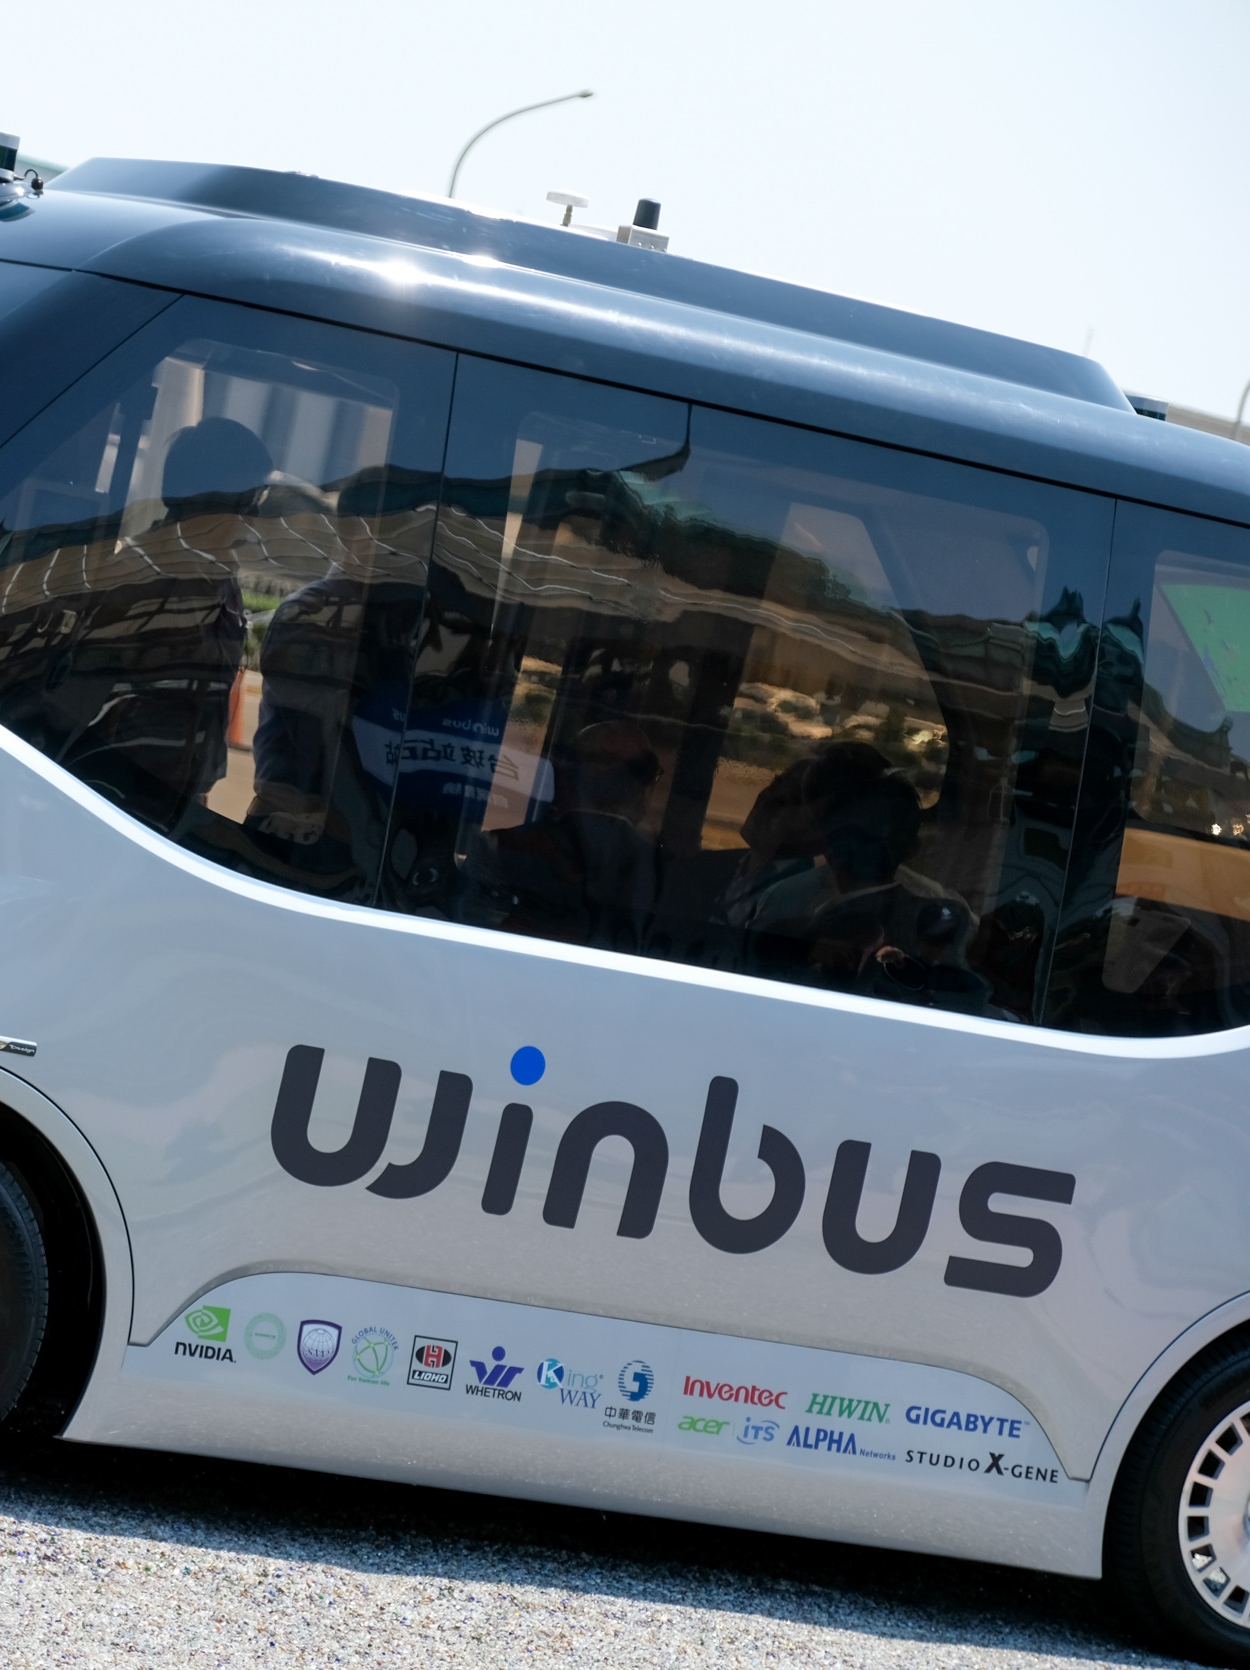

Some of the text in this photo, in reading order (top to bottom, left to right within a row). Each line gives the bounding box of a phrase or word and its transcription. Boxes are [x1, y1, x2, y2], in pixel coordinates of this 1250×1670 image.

[270, 1044, 1076, 1298] winbus
[352, 1326, 399, 1351] GLOBAL UNITEK
[413, 1371, 447, 1383] LIOHO
[465, 1384, 522, 1402] WHETRON
[560, 1388, 602, 1409] WAY
[683, 1375, 788, 1410] Inventec
[604, 1406, 656, 1425] 中華電信
[805, 1393, 891, 1424] HIWIN
[603, 1420, 654, 1434] Chunghwa Telecom
[678, 1415, 730, 1435] acer
[905, 1405, 1022, 1439] GIGABYTE
[786, 1425, 896, 1461] ALPHA Networks
[905, 1449, 1059, 1483] STUDIO X-GENE
